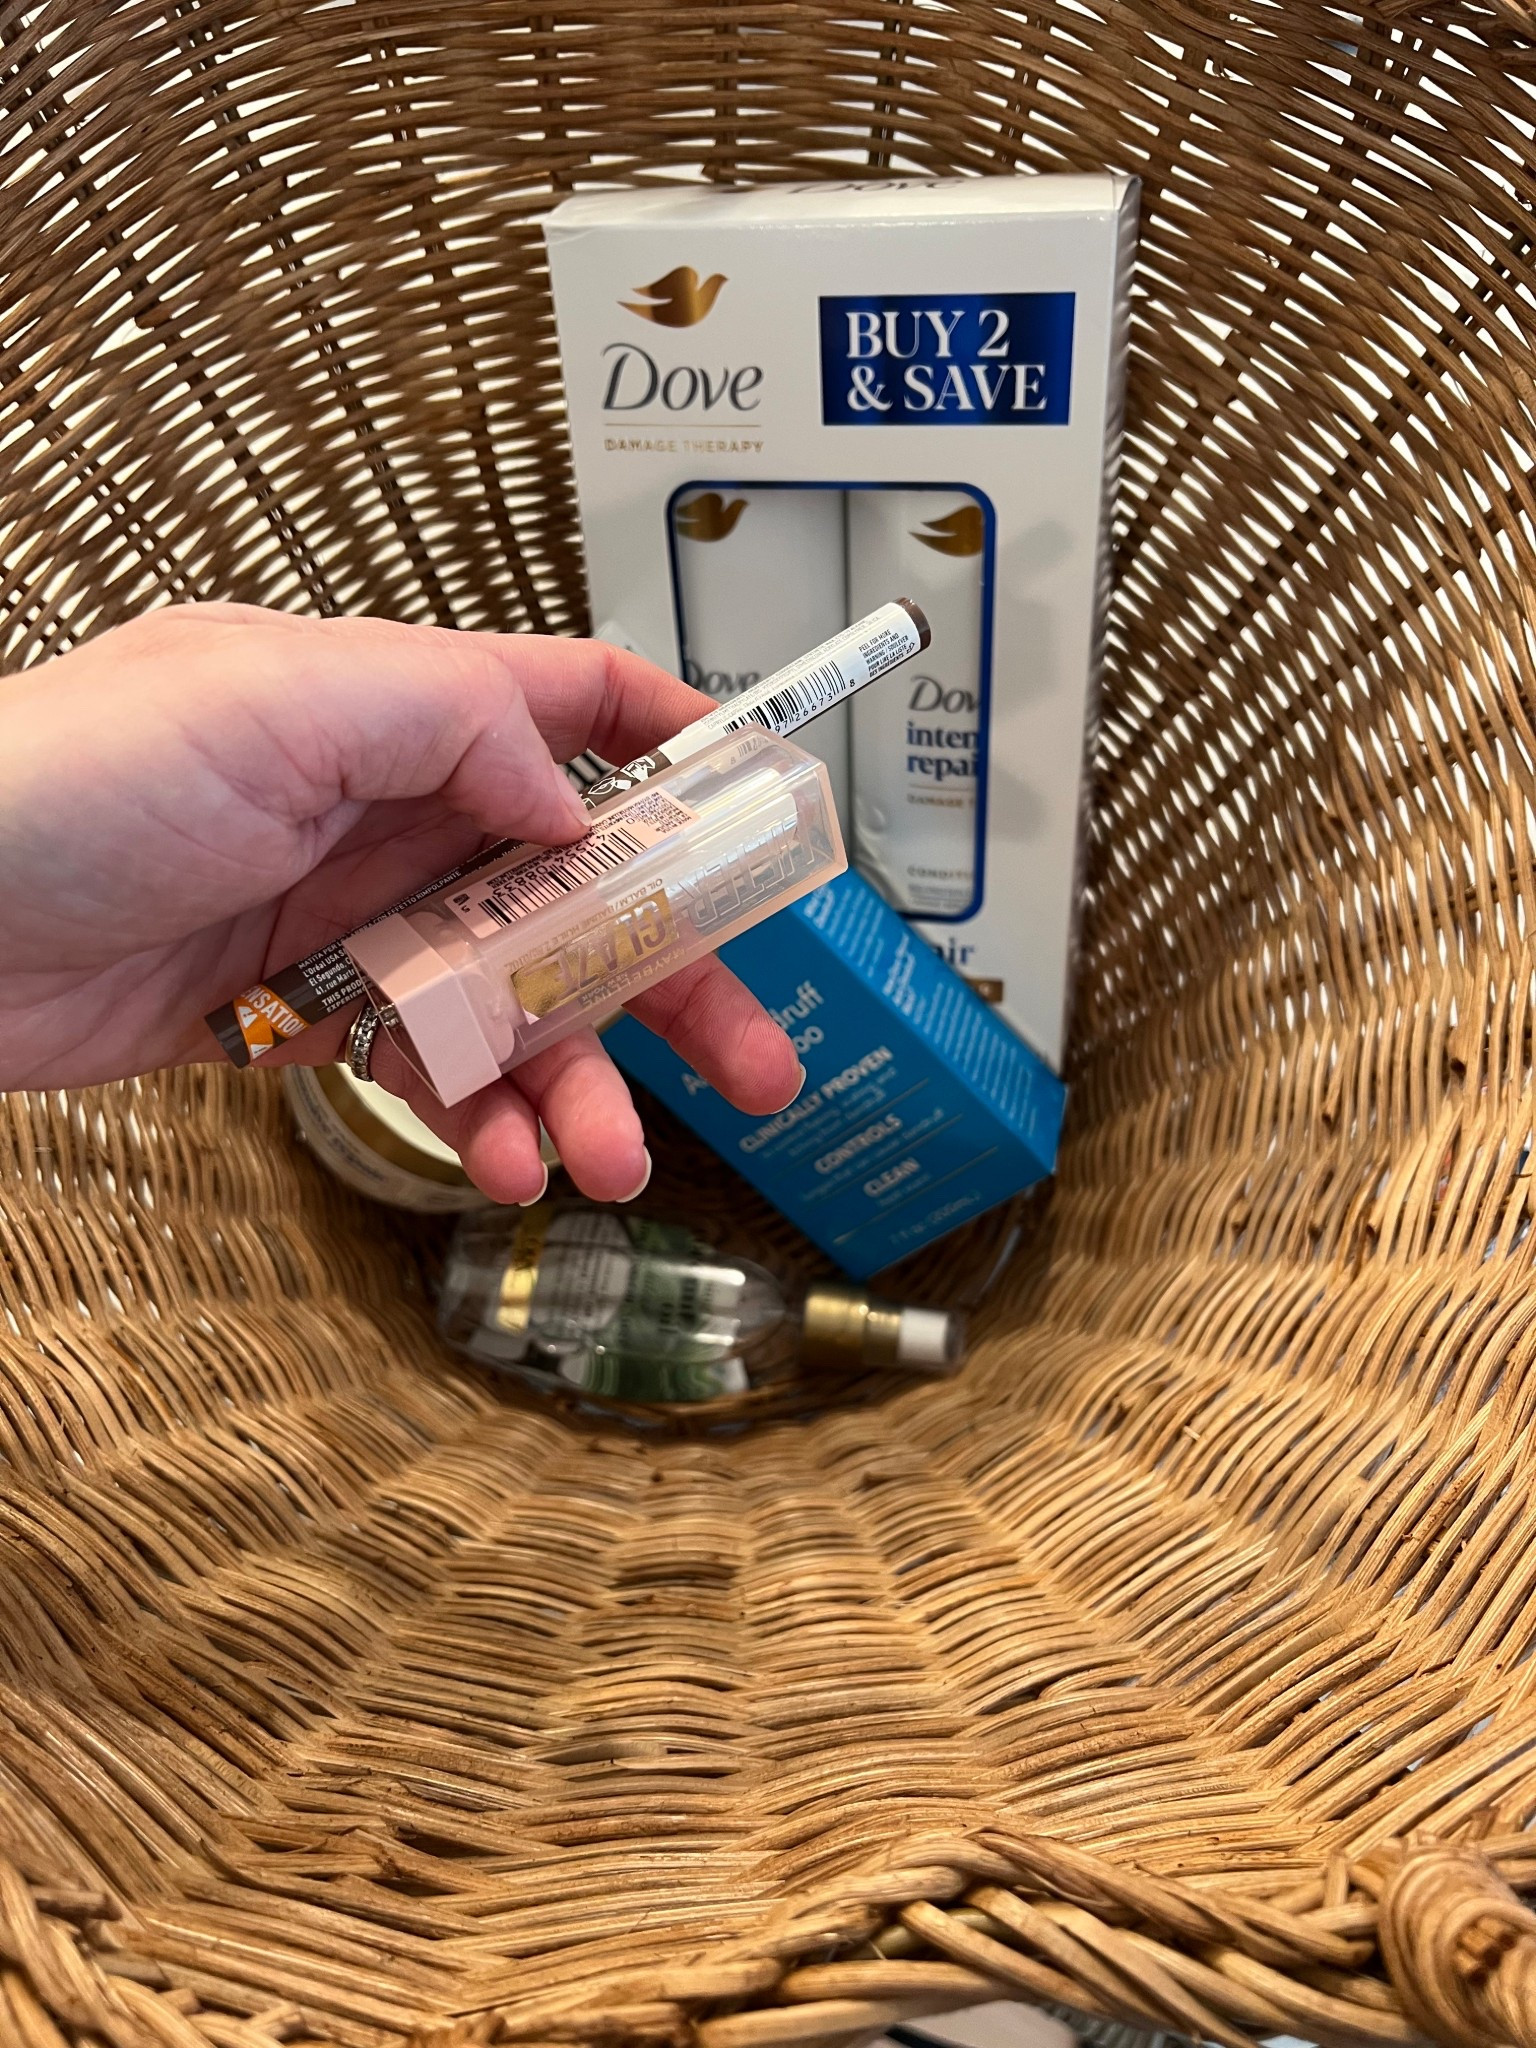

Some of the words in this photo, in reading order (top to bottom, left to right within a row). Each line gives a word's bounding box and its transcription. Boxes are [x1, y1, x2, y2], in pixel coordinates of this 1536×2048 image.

[845, 310, 965, 358] BUY
[976, 310, 1010, 358] 2
[601, 342, 764, 412] Dove
[847, 365, 893, 412] &
[903, 364, 1048, 411] SAVE
[603, 437, 678, 453] DAMAGE
[684, 438, 765, 454] THERAPY
[858, 641, 870, 652] PEEL
[868, 636, 879, 645] FOR
[877, 628, 891, 640] MORE
[862, 638, 890, 658] INGREDIENTS
[888, 632, 899, 642] AND
[865, 649, 885, 665] WARNING
[907, 675, 979, 714] Dov
[906, 720, 979, 749] inten
[906, 753, 979, 782] repai
[552, 832, 607, 867] 41554
[491, 863, 548, 900] 08833
[647, 877, 663, 890] OIL
[297, 951, 324, 969] MATITA
[414, 869, 462, 900] RIMPOLPANTE
[460, 904, 470, 914] 5
[302, 959, 327, 977] L'Oréal
[324, 952, 339, 965] USA
[535, 898, 671, 1003] GLAZE
[308, 976, 318, 986] El
[315, 960, 347, 983] Segundo,
[314, 984, 327, 996] 41,
[325, 978, 338, 989] rue
[336, 967, 356, 983] Martr
[321, 991, 341, 1006] THIS
[339, 978, 362, 995] PROD
[325, 985, 367, 1013] EXPERIENC
[736, 1089, 826, 1157] CLINICALLY
[818, 1043, 894, 1101] PROVEN
[812, 1110, 905, 1179] CONTROLS
[860, 1154, 922, 1200] CLEAN
